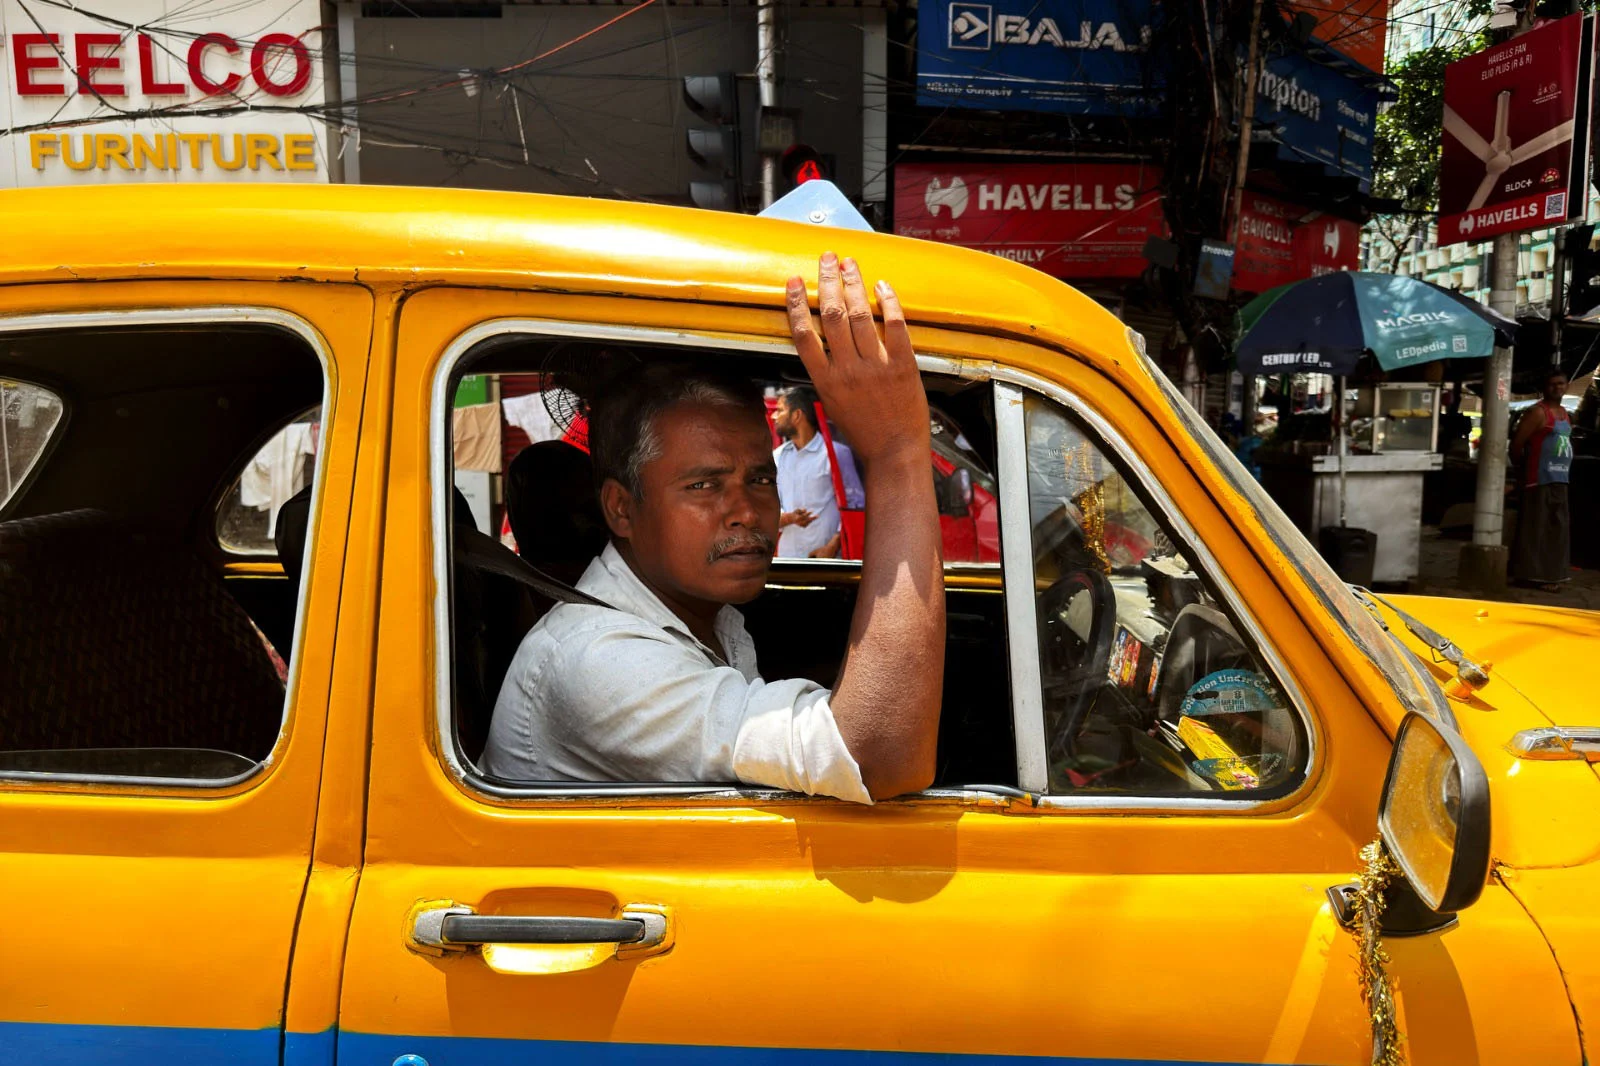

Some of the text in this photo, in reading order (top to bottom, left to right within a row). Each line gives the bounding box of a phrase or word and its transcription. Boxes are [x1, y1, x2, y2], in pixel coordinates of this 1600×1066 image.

[0, 32, 312, 96] EELCO
[1488, 42, 1527, 65] HAVELLS FAN
[1481, 67, 1494, 80] ELIO
[1495, 62, 1510, 75] PLUS
[29, 133, 317, 171] FURNITURE
[978, 184, 1135, 211] HAVELLS
[1477, 202, 1538, 228] HAVELLS
[1241, 216, 1292, 244] GANGULY
[1262, 352, 1302, 366] CENTURY
[1302, 352, 1320, 364] LED
[1396, 340, 1447, 360] LEDpedia
[1218, 674, 1252, 685] Under
